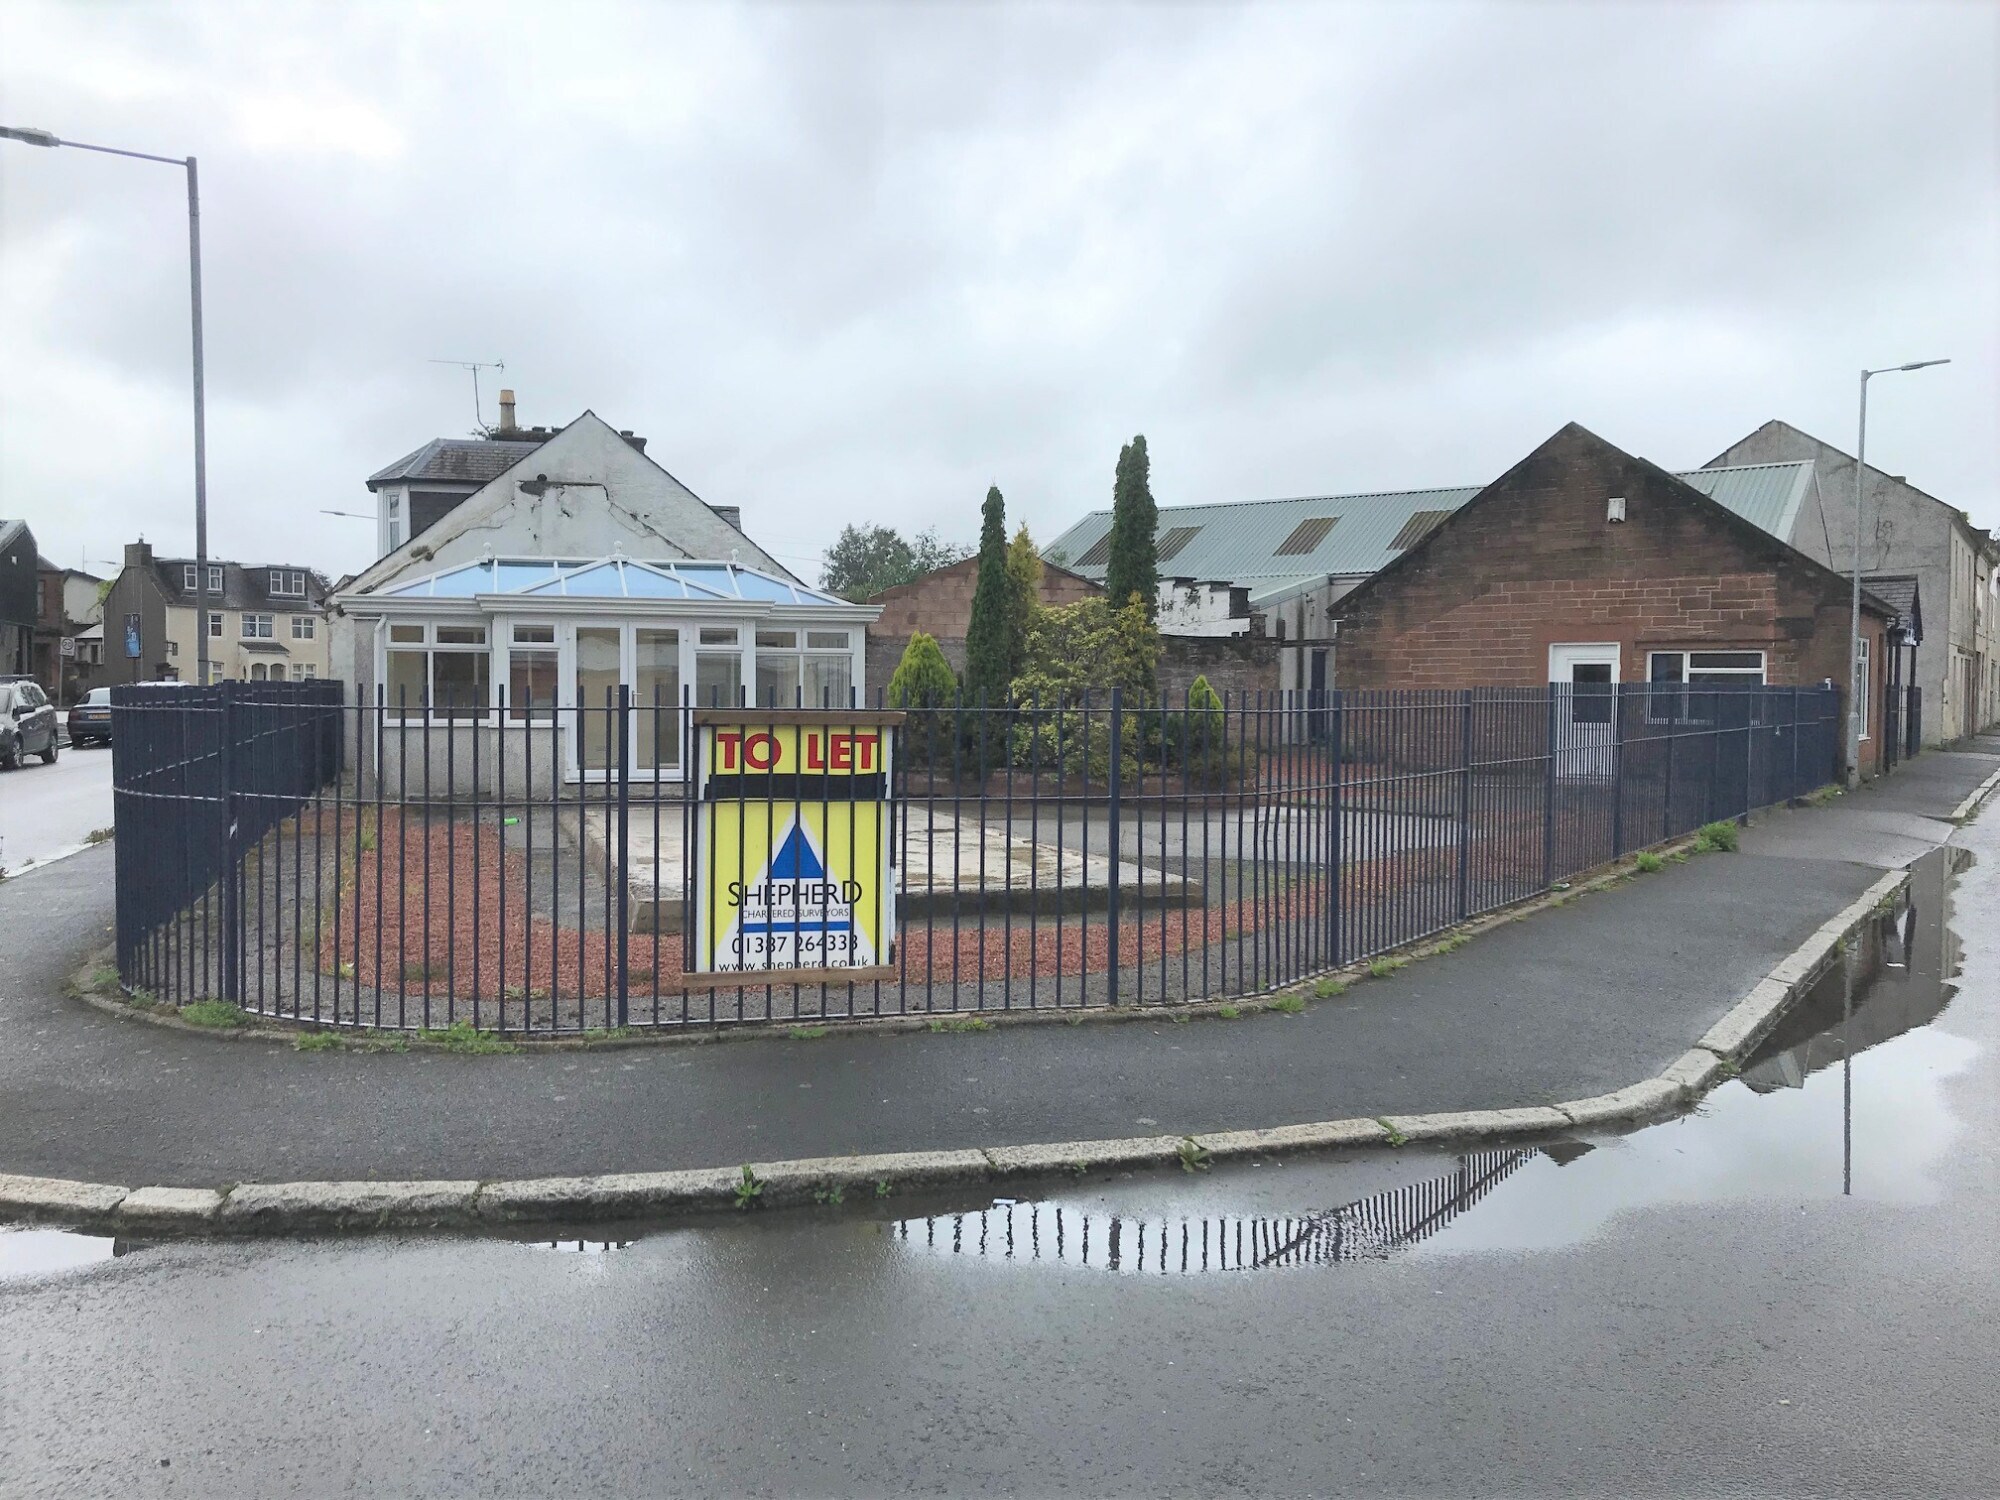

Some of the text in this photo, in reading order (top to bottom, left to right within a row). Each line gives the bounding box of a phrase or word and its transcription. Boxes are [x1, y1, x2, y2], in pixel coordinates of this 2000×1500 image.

[718, 733, 878, 769] TO LET
[728, 880, 863, 907] SHEPHERD
[742, 909, 794, 919] CHARERED
[732, 935, 858, 954] 01387 264333
[719, 956, 868, 972] www.sepercouk
